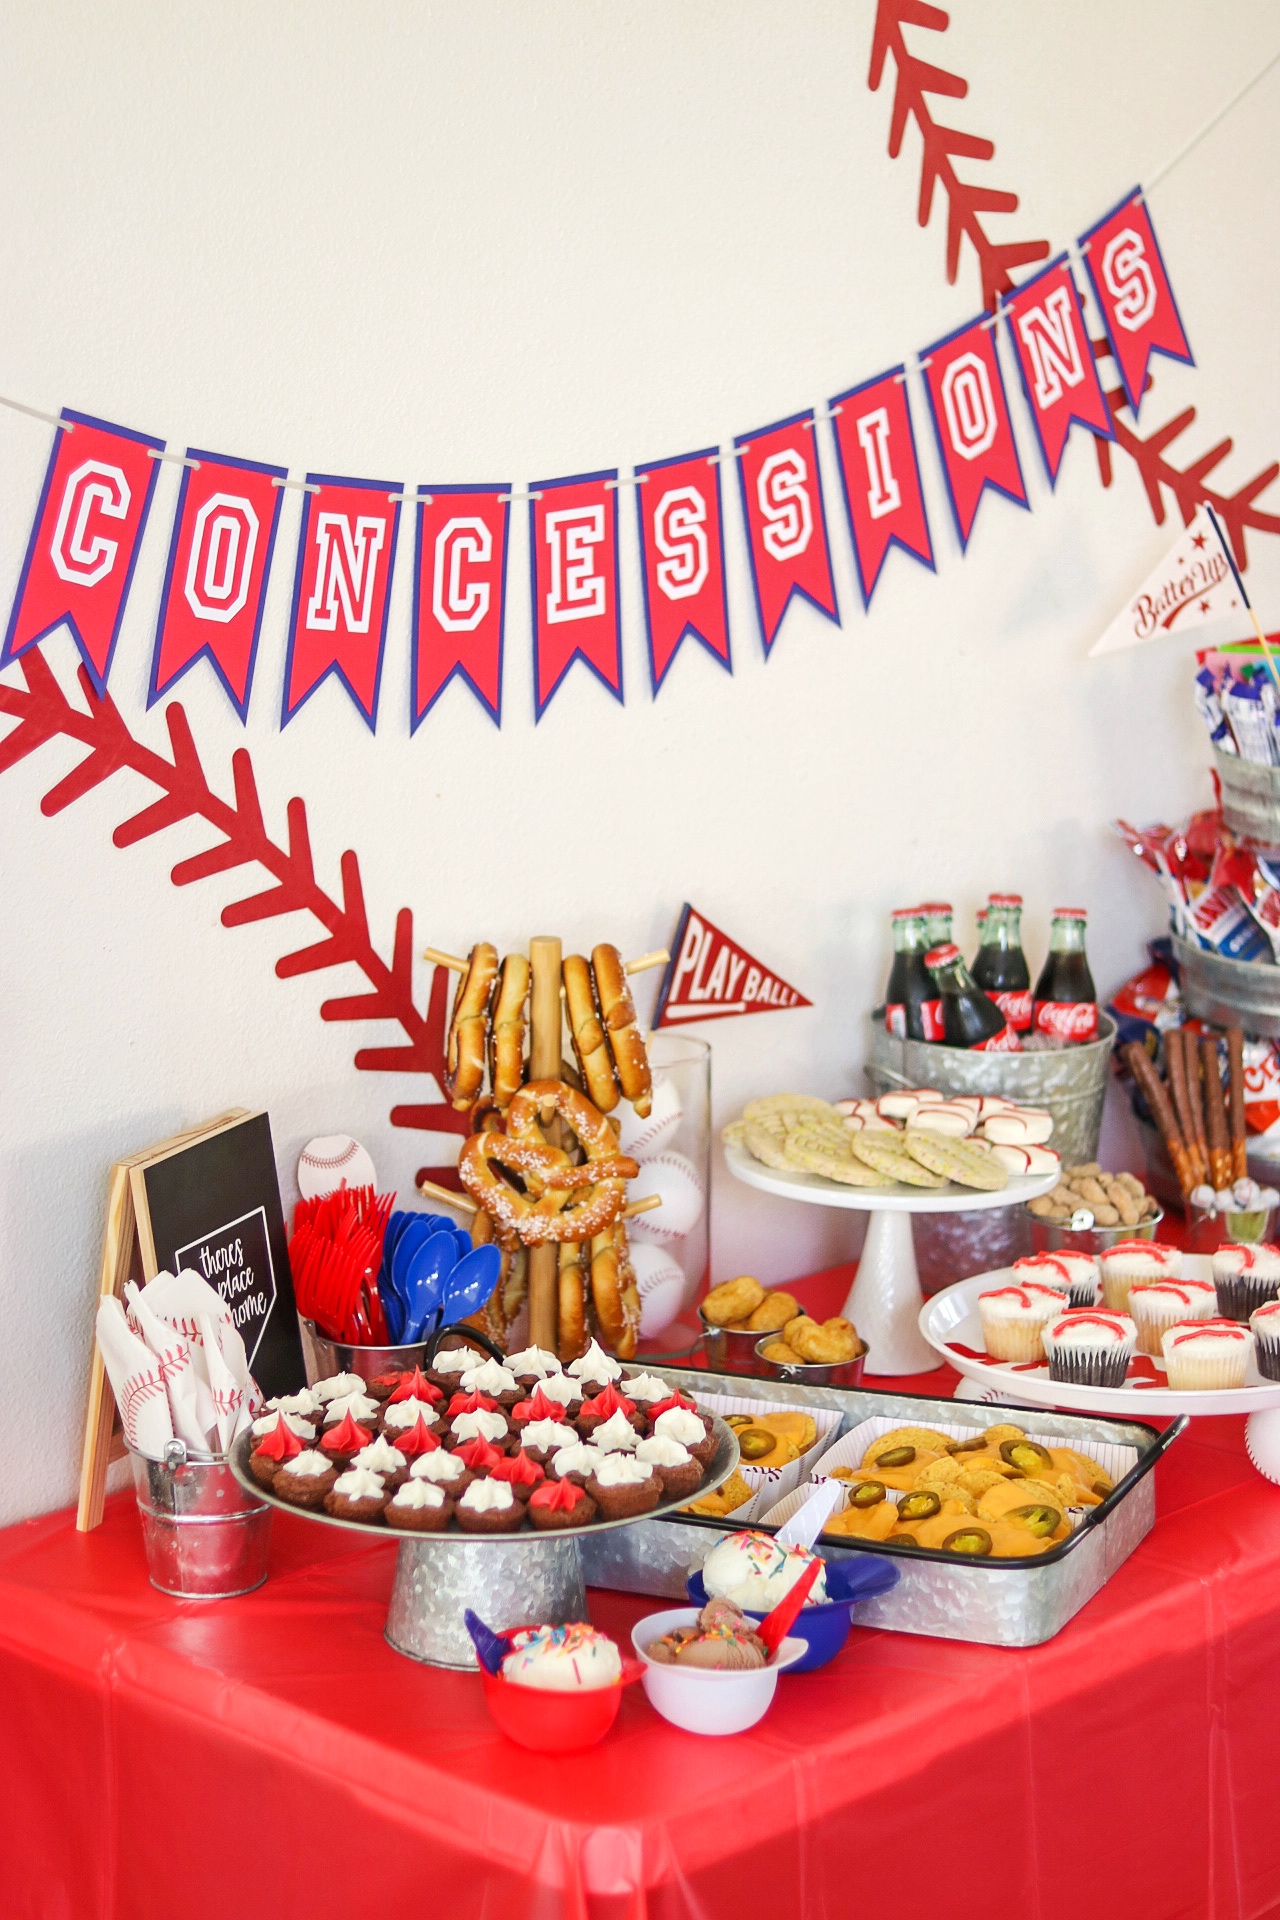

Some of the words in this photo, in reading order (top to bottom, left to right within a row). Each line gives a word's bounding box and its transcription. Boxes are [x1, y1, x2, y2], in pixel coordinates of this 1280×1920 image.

[50, 227, 1158, 634] CONCESSIONS
[1133, 573, 1198, 640] Batter
[1190, 551, 1229, 584] Up
[668, 914, 747, 1003] PLAY
[741, 965, 799, 1007] BALL!
[199, 1238, 244, 1279] theres
[217, 1267, 255, 1300] place
